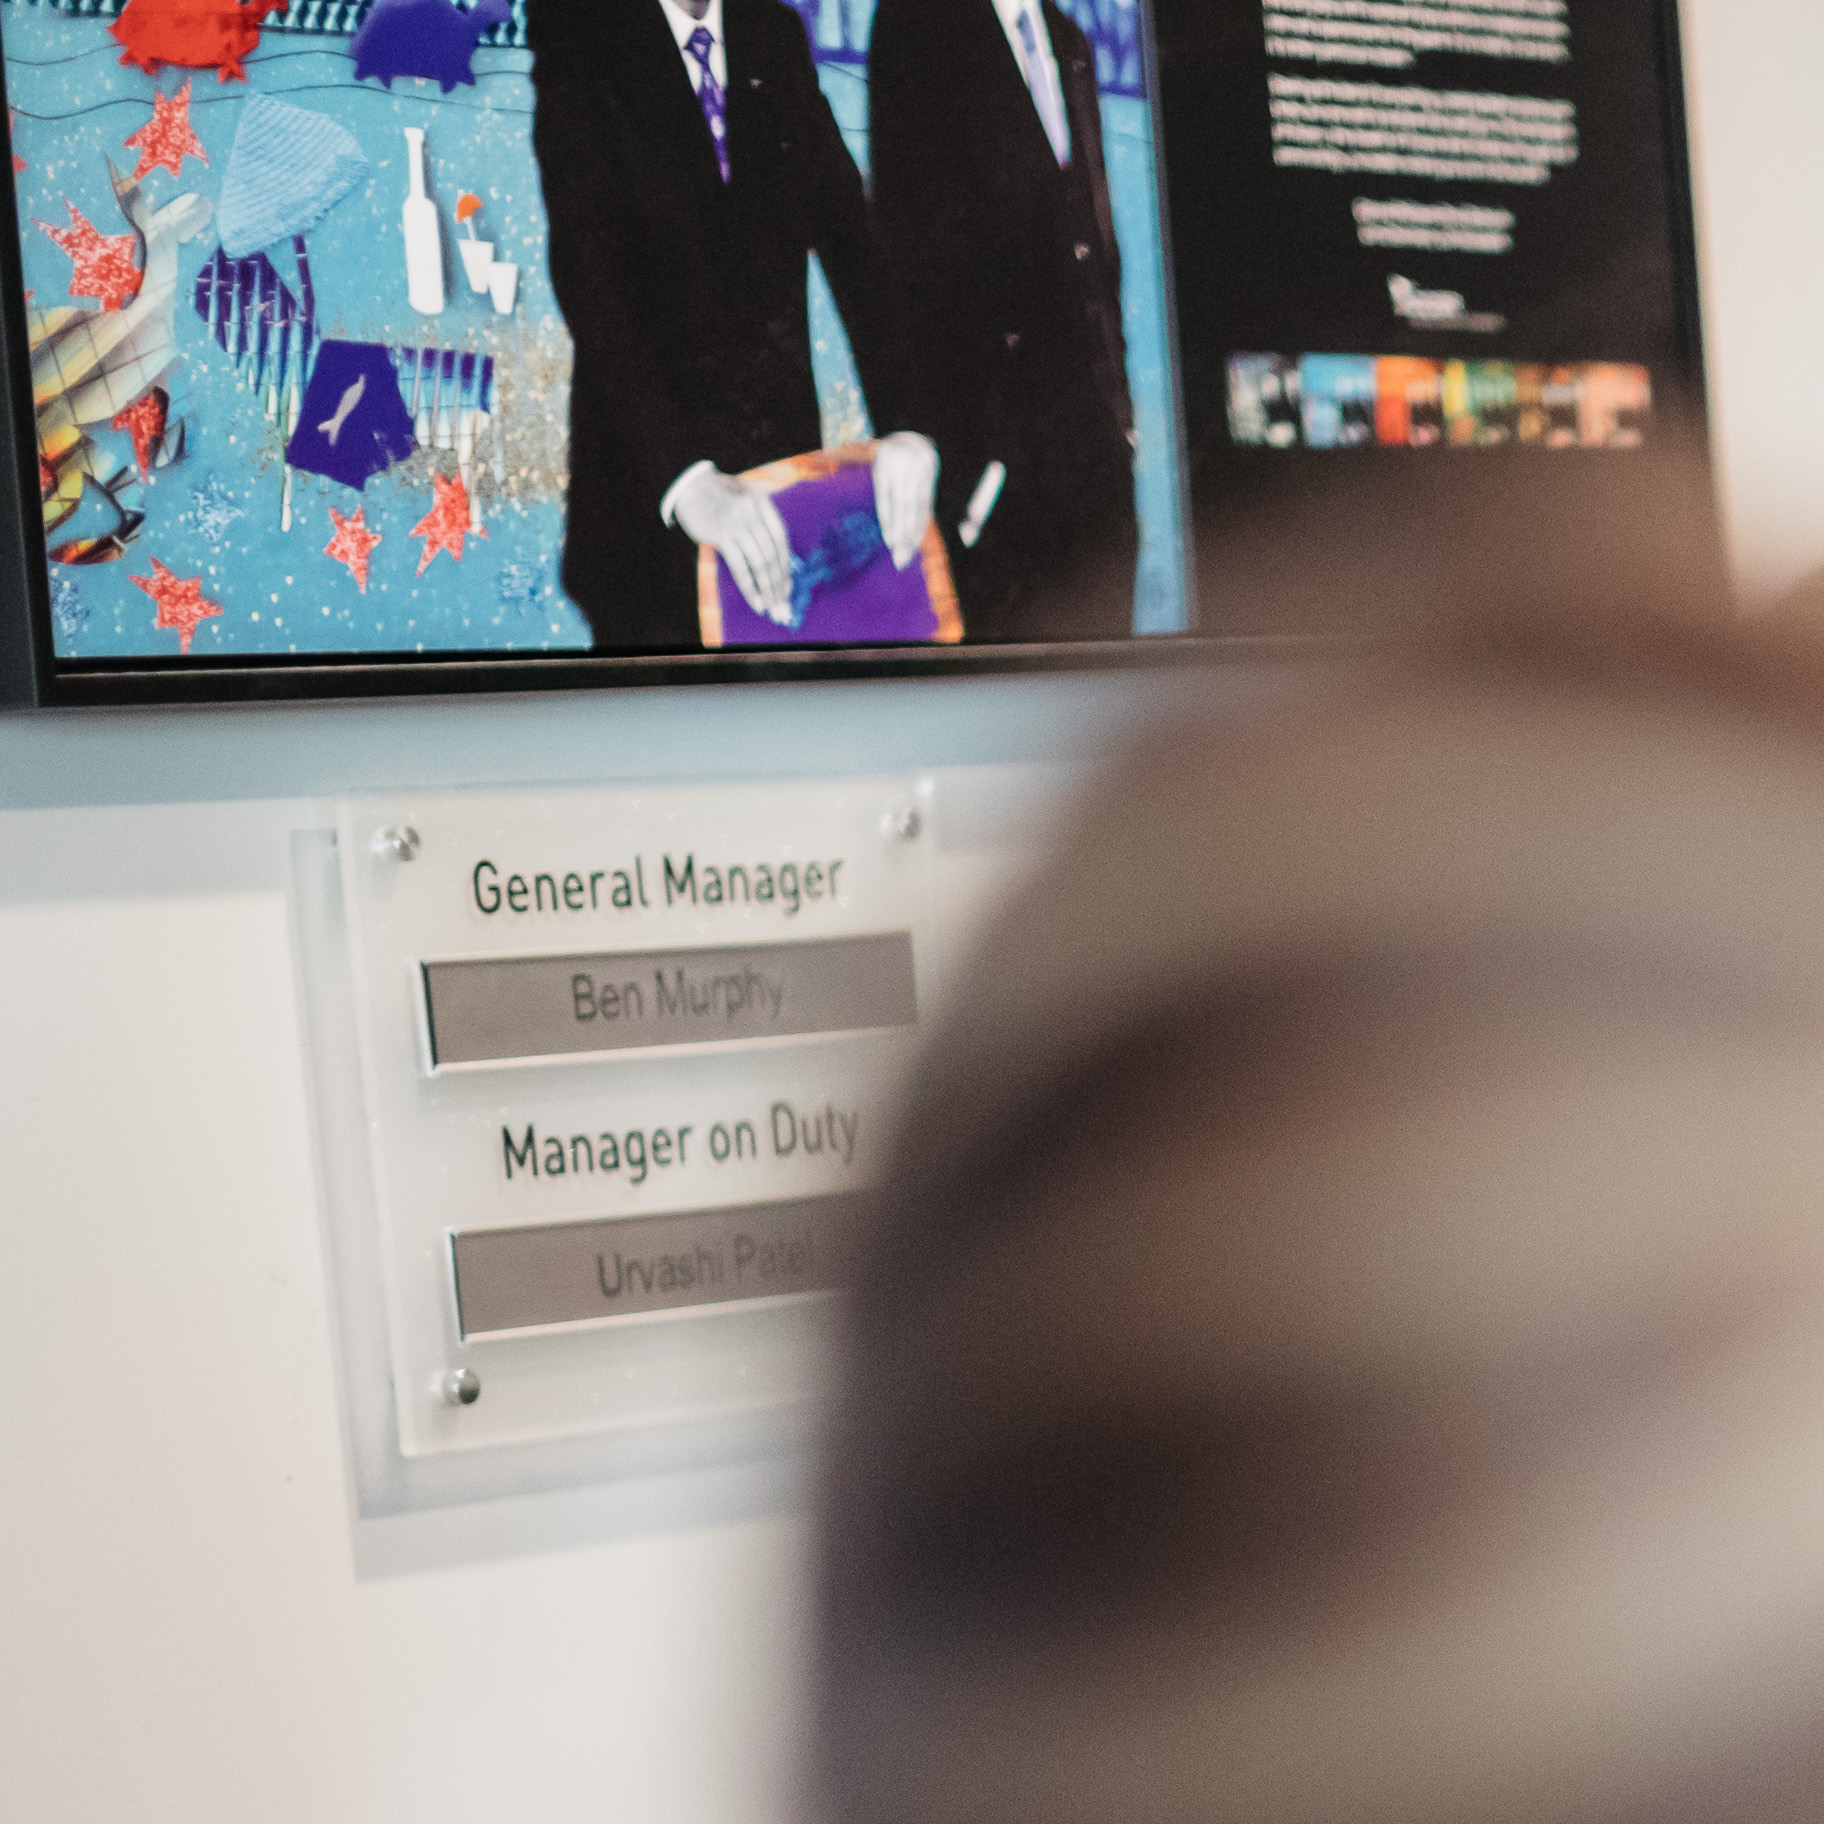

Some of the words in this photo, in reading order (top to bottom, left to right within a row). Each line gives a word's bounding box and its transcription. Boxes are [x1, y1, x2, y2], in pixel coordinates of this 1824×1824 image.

[473, 853, 651, 915] General
[662, 852, 845, 917] Manager
[570, 972, 645, 1022] Ben
[655, 963, 784, 1023] Murphy
[501, 1122, 694, 1186] Manager
[709, 1119, 758, 1162] on
[770, 1101, 861, 1165] Duty
[597, 1238, 723, 1299] Urvashi
